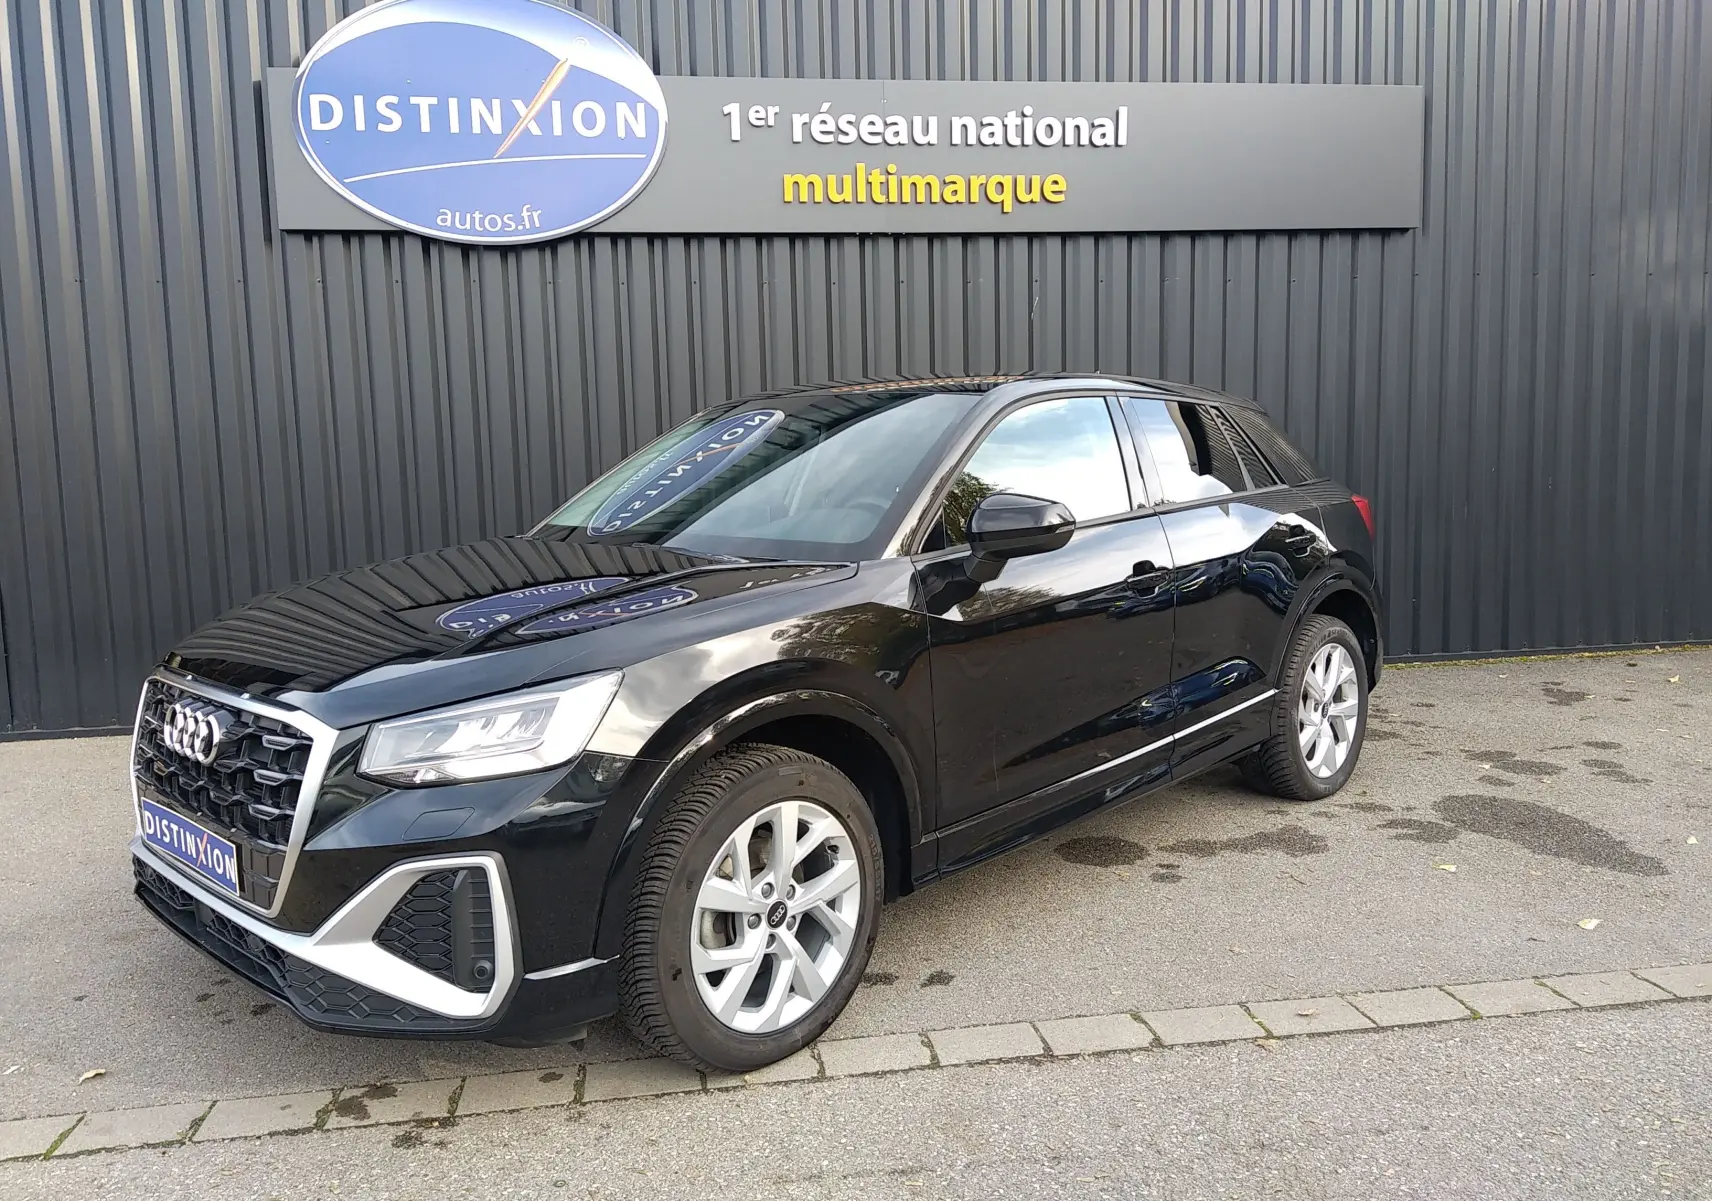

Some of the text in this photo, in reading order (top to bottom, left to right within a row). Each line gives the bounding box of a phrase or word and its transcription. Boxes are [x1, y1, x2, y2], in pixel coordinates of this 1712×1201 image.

[308, 92, 648, 140] DISTINXION
[722, 102, 1128, 146] 1er réseau national
[783, 162, 1067, 213] multimarque
[436, 204, 543, 233] autos.fr
[144, 811, 236, 883] DISTINXION
